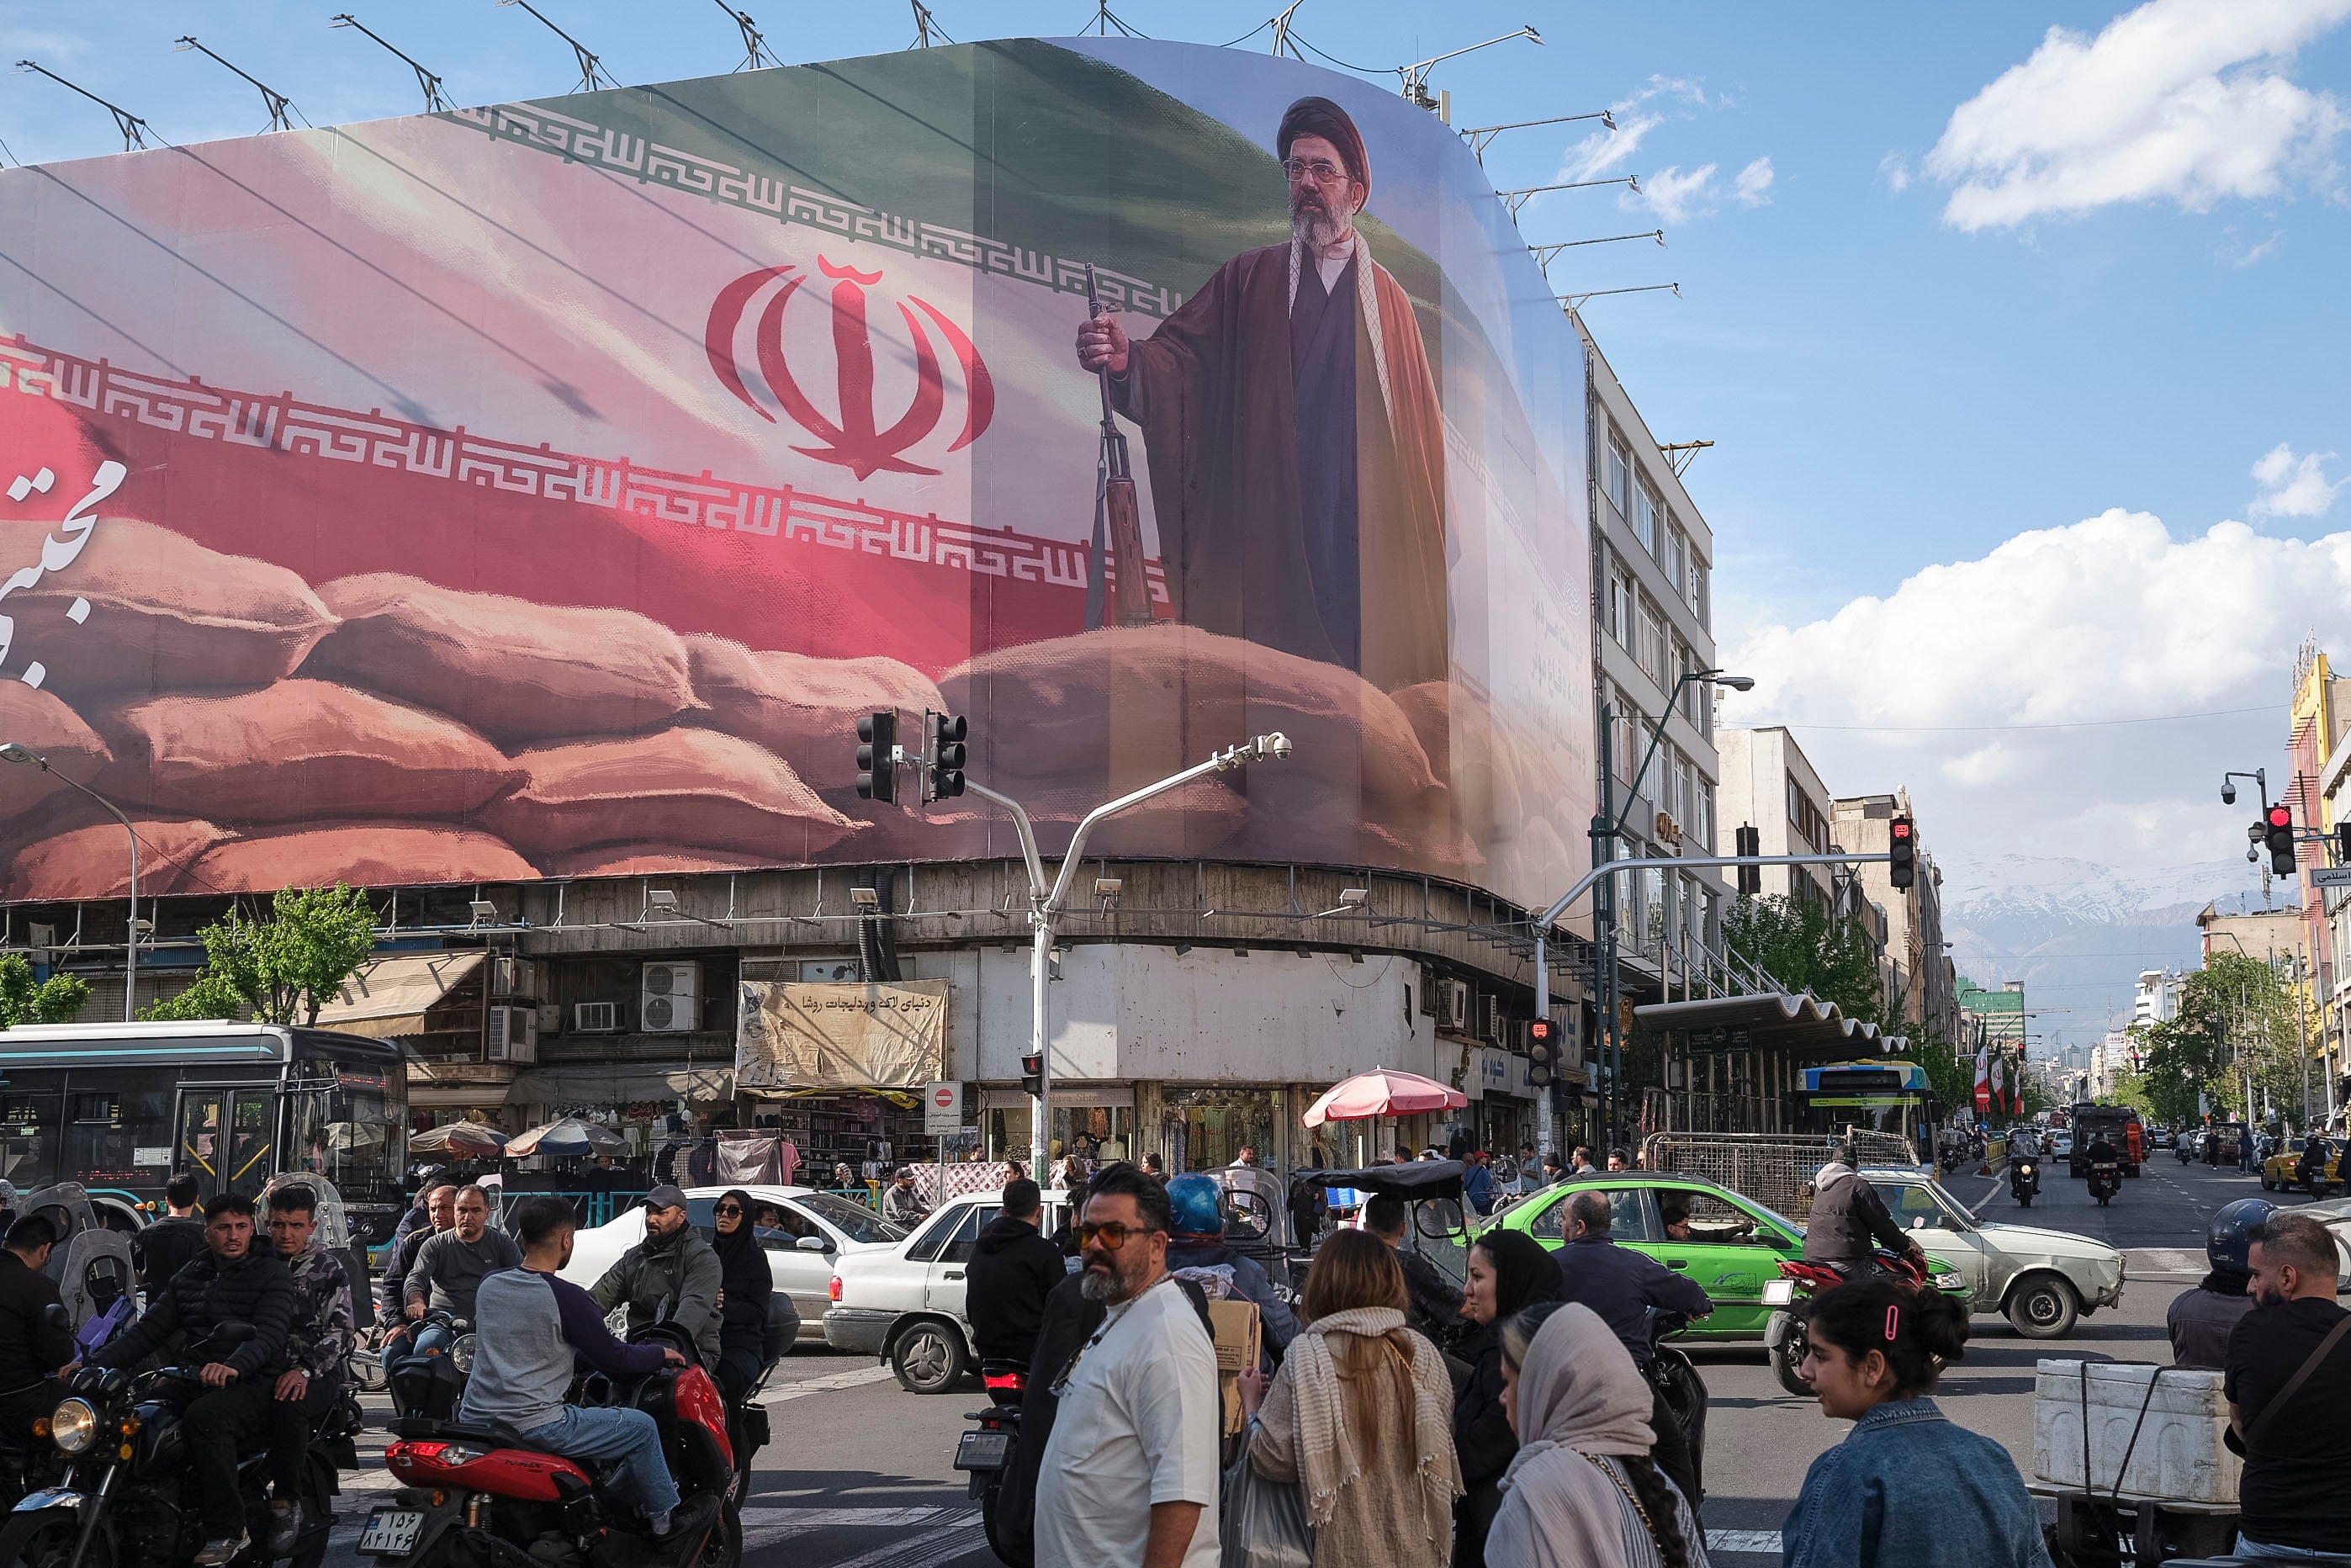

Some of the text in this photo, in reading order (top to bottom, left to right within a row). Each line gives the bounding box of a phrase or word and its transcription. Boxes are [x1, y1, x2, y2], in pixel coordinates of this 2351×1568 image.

[2317, 871, 2350, 882] اسلامی
[802, 995, 823, 1013] روشا
[879, 995, 898, 1009] لاک
[901, 998, 931, 1012] دنیای
[1077, 1093, 1102, 1102] Shiva
[389, 1514, 416, 1528] ۱۵۶
[363, 1533, 413, 1549] ۸۴۱۴۶
